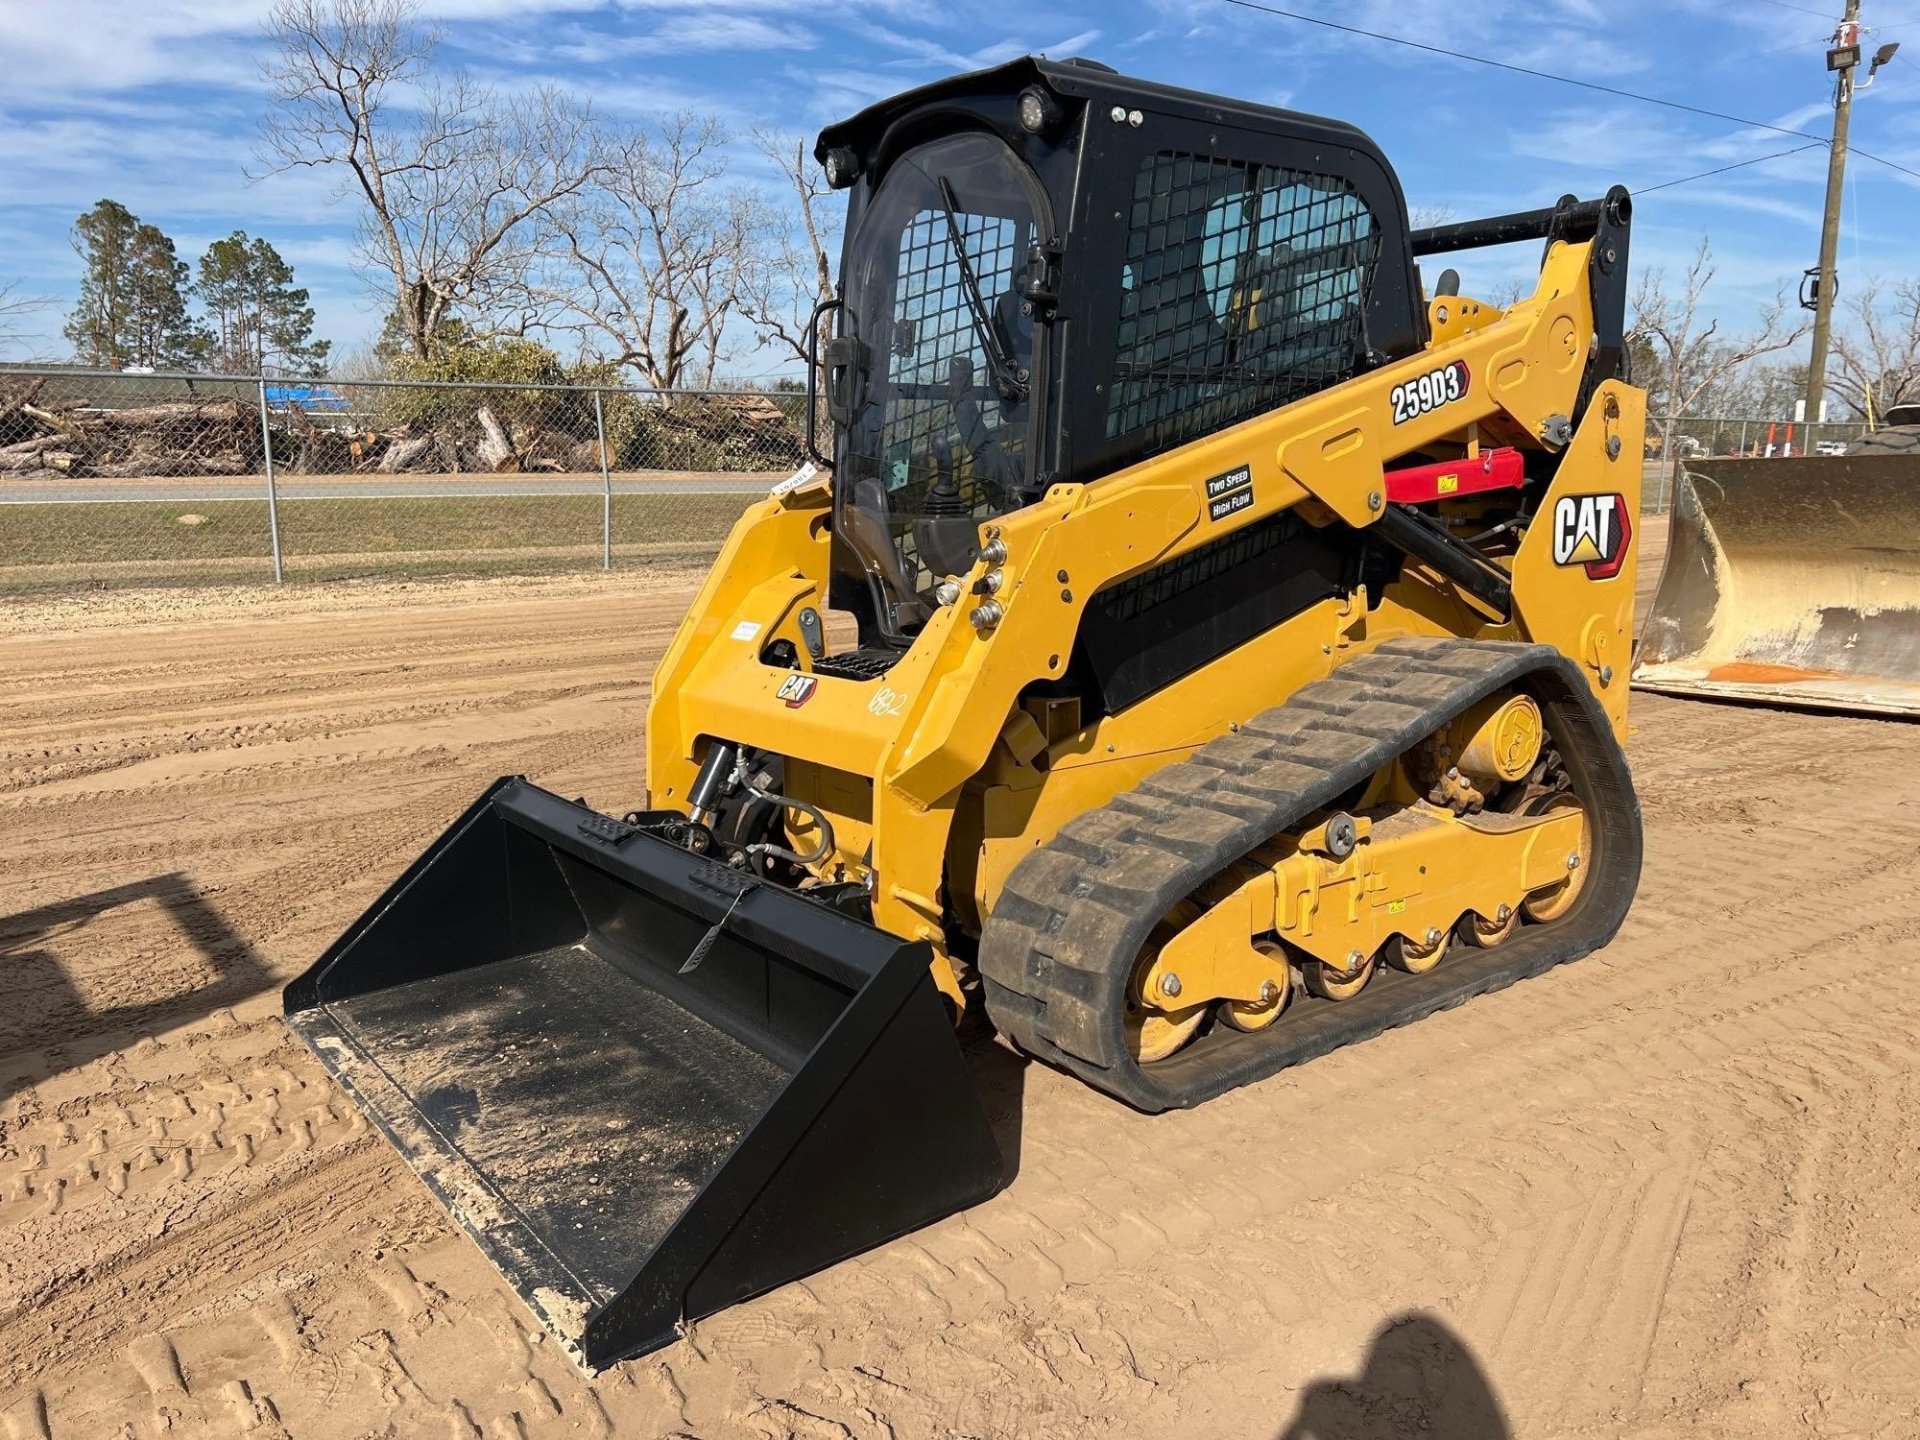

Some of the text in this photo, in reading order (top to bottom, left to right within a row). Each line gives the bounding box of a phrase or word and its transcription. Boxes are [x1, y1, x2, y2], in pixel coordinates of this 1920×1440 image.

[1390, 364, 1461, 424] 259D3
[1226, 470, 1249, 487] SPEED
[1212, 492, 1251, 517] HIGH FLOW
[1554, 495, 1615, 564] CAT
[777, 674, 817, 701] CAT
